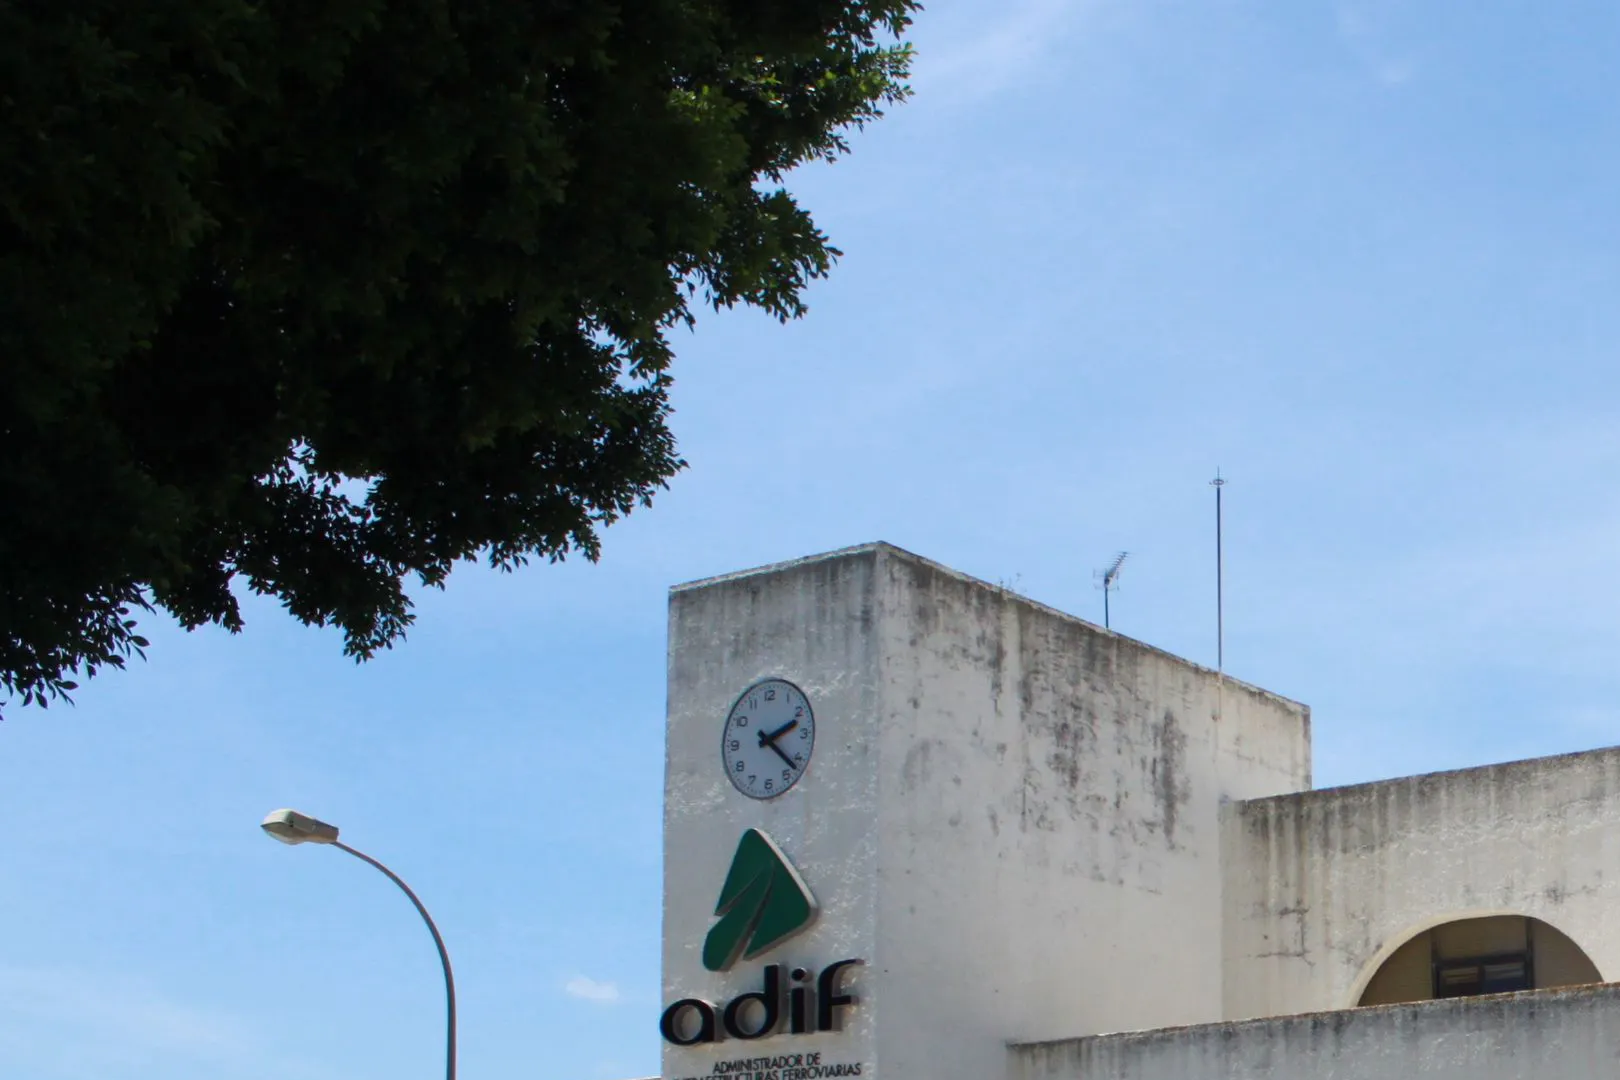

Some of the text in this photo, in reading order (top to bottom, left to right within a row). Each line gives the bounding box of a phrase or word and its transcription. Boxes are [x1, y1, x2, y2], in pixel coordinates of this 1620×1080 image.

[763, 689, 777, 701] 12
[786, 694, 791, 704] 1
[749, 699, 758, 709] 11
[794, 706, 804, 717] 2
[736, 715, 749, 727] 10
[800, 728, 808, 739] 3
[730, 740, 740, 751] 9
[735, 760, 745, 772] 8
[748, 774, 757, 786] 7
[782, 769, 791, 781] 5
[764, 778, 774, 790] 6
[659, 958, 866, 1048] adif
[713, 1052, 821, 1075] ADMINISTRADOR DE
